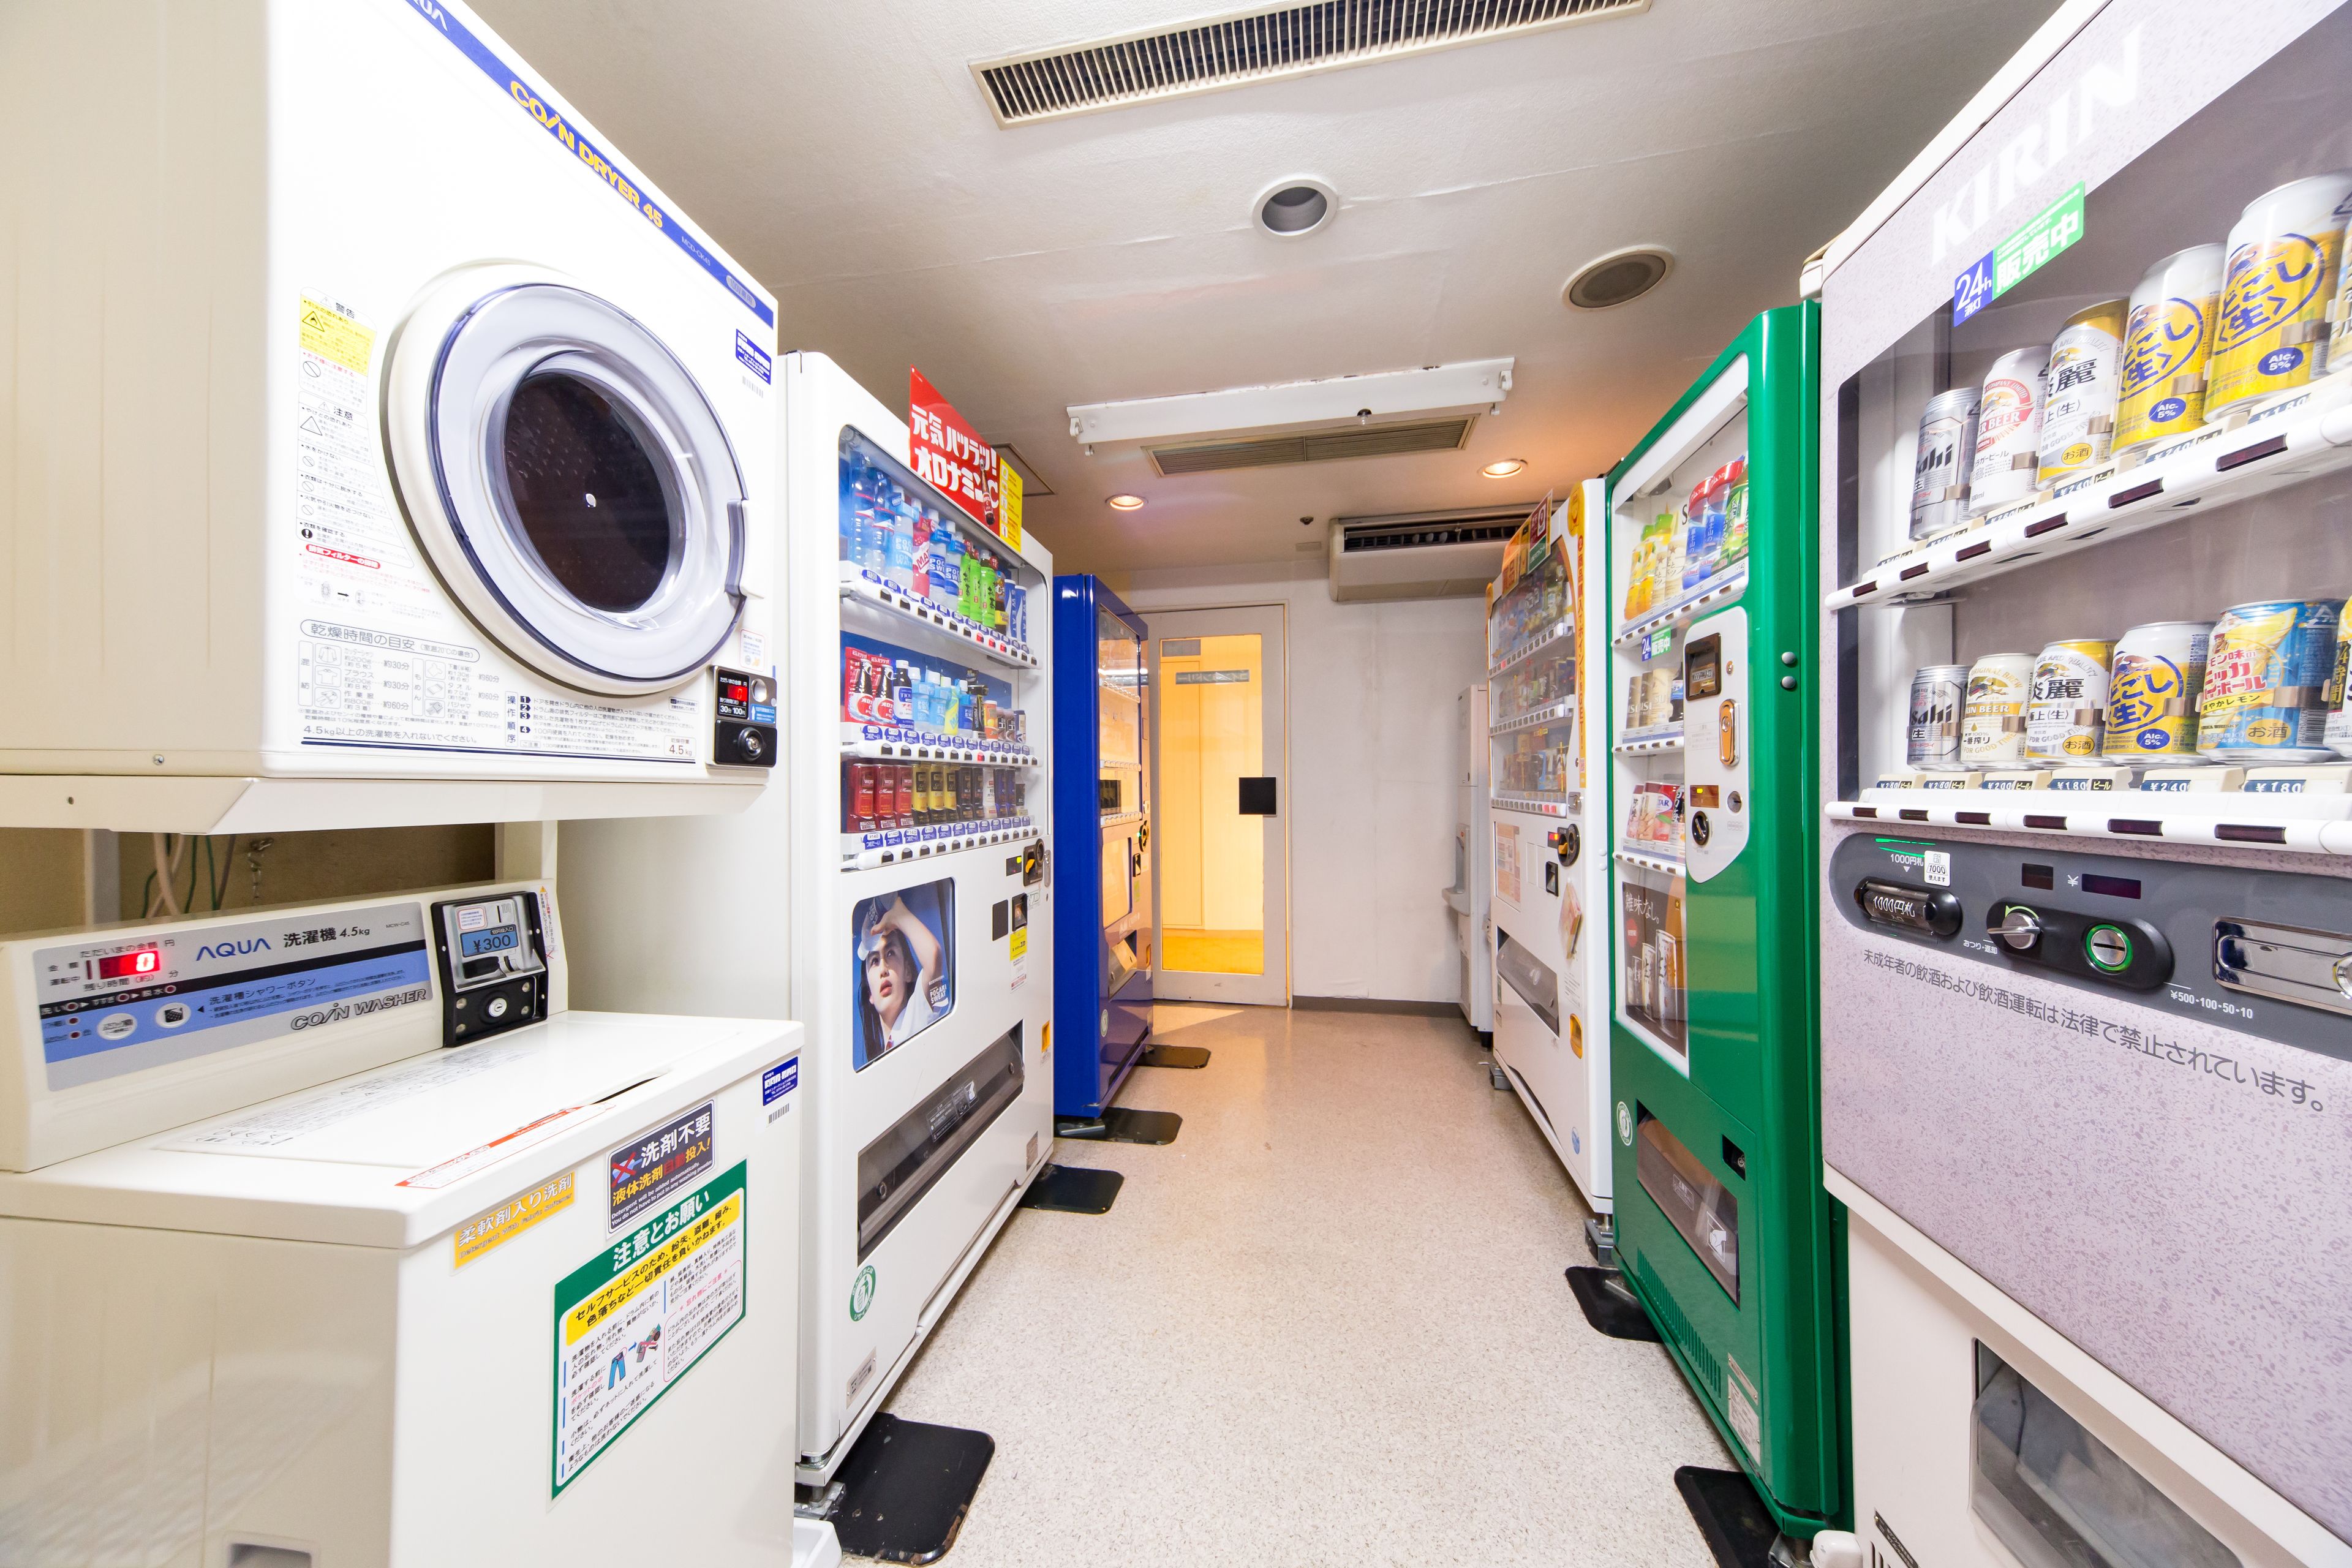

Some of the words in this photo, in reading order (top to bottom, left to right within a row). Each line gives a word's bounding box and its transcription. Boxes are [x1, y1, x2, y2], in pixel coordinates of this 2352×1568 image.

[1931, 22, 2142, 268] KIRIN
[579, 141, 640, 209] DRYER
[643, 203, 663, 228] 45
[1996, 210, 2078, 293] 販売中
[1956, 262, 1992, 312] 24h
[336, 303, 355, 318] 警告
[2269, 360, 2291, 371] 5%
[334, 406, 353, 421] 注意
[2157, 402, 2179, 412] Alc.
[2157, 409, 2176, 418] 5%
[1988, 412, 2020, 429] BEER
[911, 404, 997, 477] 元気ハツラツ!
[2063, 447, 2089, 460] お酒
[311, 624, 415, 650] 乾燥時間の目安
[383, 660, 409, 670] 約30分
[2067, 656, 2098, 677] QUALITY
[383, 680, 409, 690] 約30分
[478, 674, 499, 683] 約60分
[2002, 671, 2023, 688] BREW
[478, 692, 499, 701] 約60分
[737, 688, 742, 699] 0
[383, 701, 409, 710] 約60分
[1979, 704, 2010, 714] BEER
[507, 696, 516, 743] 操作順序
[1912, 729, 1925, 739] 生
[2028, 735, 2041, 744] FOR
[2041, 733, 2065, 742] GOOD
[2247, 722, 2288, 739] お酒
[669, 745, 684, 755] 4.5
[1975, 744, 1997, 754] GOOD
[2064, 739, 2093, 751] お酒
[2057, 782, 2087, 790] ¥180
[2093, 780, 2111, 790] ビール
[1890, 854, 1924, 867] 1000円札
[1933, 853, 1942, 863] 新
[1929, 864, 1947, 874] 1000
[1928, 875, 1947, 883] 使えます
[2067, 875, 2079, 887] ¥
[1624, 892, 1659, 924] 雑味なし。
[1872, 895, 1915, 918] 1000円札
[284, 927, 336, 948] 洗濯機
[339, 926, 371, 938] 4.5kg
[473, 935, 511, 952] ¥300
[80, 941, 158, 958] ただいまの金額
[196, 938, 272, 961] AQUA
[1963, 939, 1998, 954] おつり・返却
[135, 952, 155, 972] 0
[83, 978, 130, 992] 残り時間
[209, 977, 316, 1005] 洗濯槽シャワーボタン
[929, 984, 947, 998] POCARI
[354, 988, 426, 1016] WASHER
[930, 991, 947, 1004] SWEAT
[1863, 948, 2323, 1112] 未成年者の飲酒および飲酒運転は法律で禁止されています。
[641, 1112, 710, 1169] 洗剤不要
[612, 1137, 710, 1207] 液体洗剤自動投入!
[612, 1197, 638, 1219] Detergent
[638, 1193, 647, 1202] will
[648, 1189, 655, 1198] be
[655, 1179, 669, 1193] added
[670, 1162, 700, 1183] automatically.
[612, 1218, 622, 1226] You
[630, 1207, 638, 1215] not
[639, 1199, 650, 1210] have
[670, 1182, 679, 1191] any
[679, 1169, 696, 1185] washing
[458, 1172, 573, 1247] 柔軟剤入り洗剤
[460, 1232, 500, 1259] Detergent
[521, 1210, 543, 1224] Fabric
[545, 1193, 573, 1212] Softener
[612, 1190, 709, 1272] 注意とお願い
[576, 1205, 732, 1321] セルフサービスのため、紛失、盗難、縮み、
[587, 1220, 726, 1327] 色落ちなど一切責任を負いかねます。
[571, 1332, 627, 1379] 必ず確認してください。
[571, 1365, 606, 1398] 洗濯する前に
[571, 1376, 603, 1405] ポケットの中
